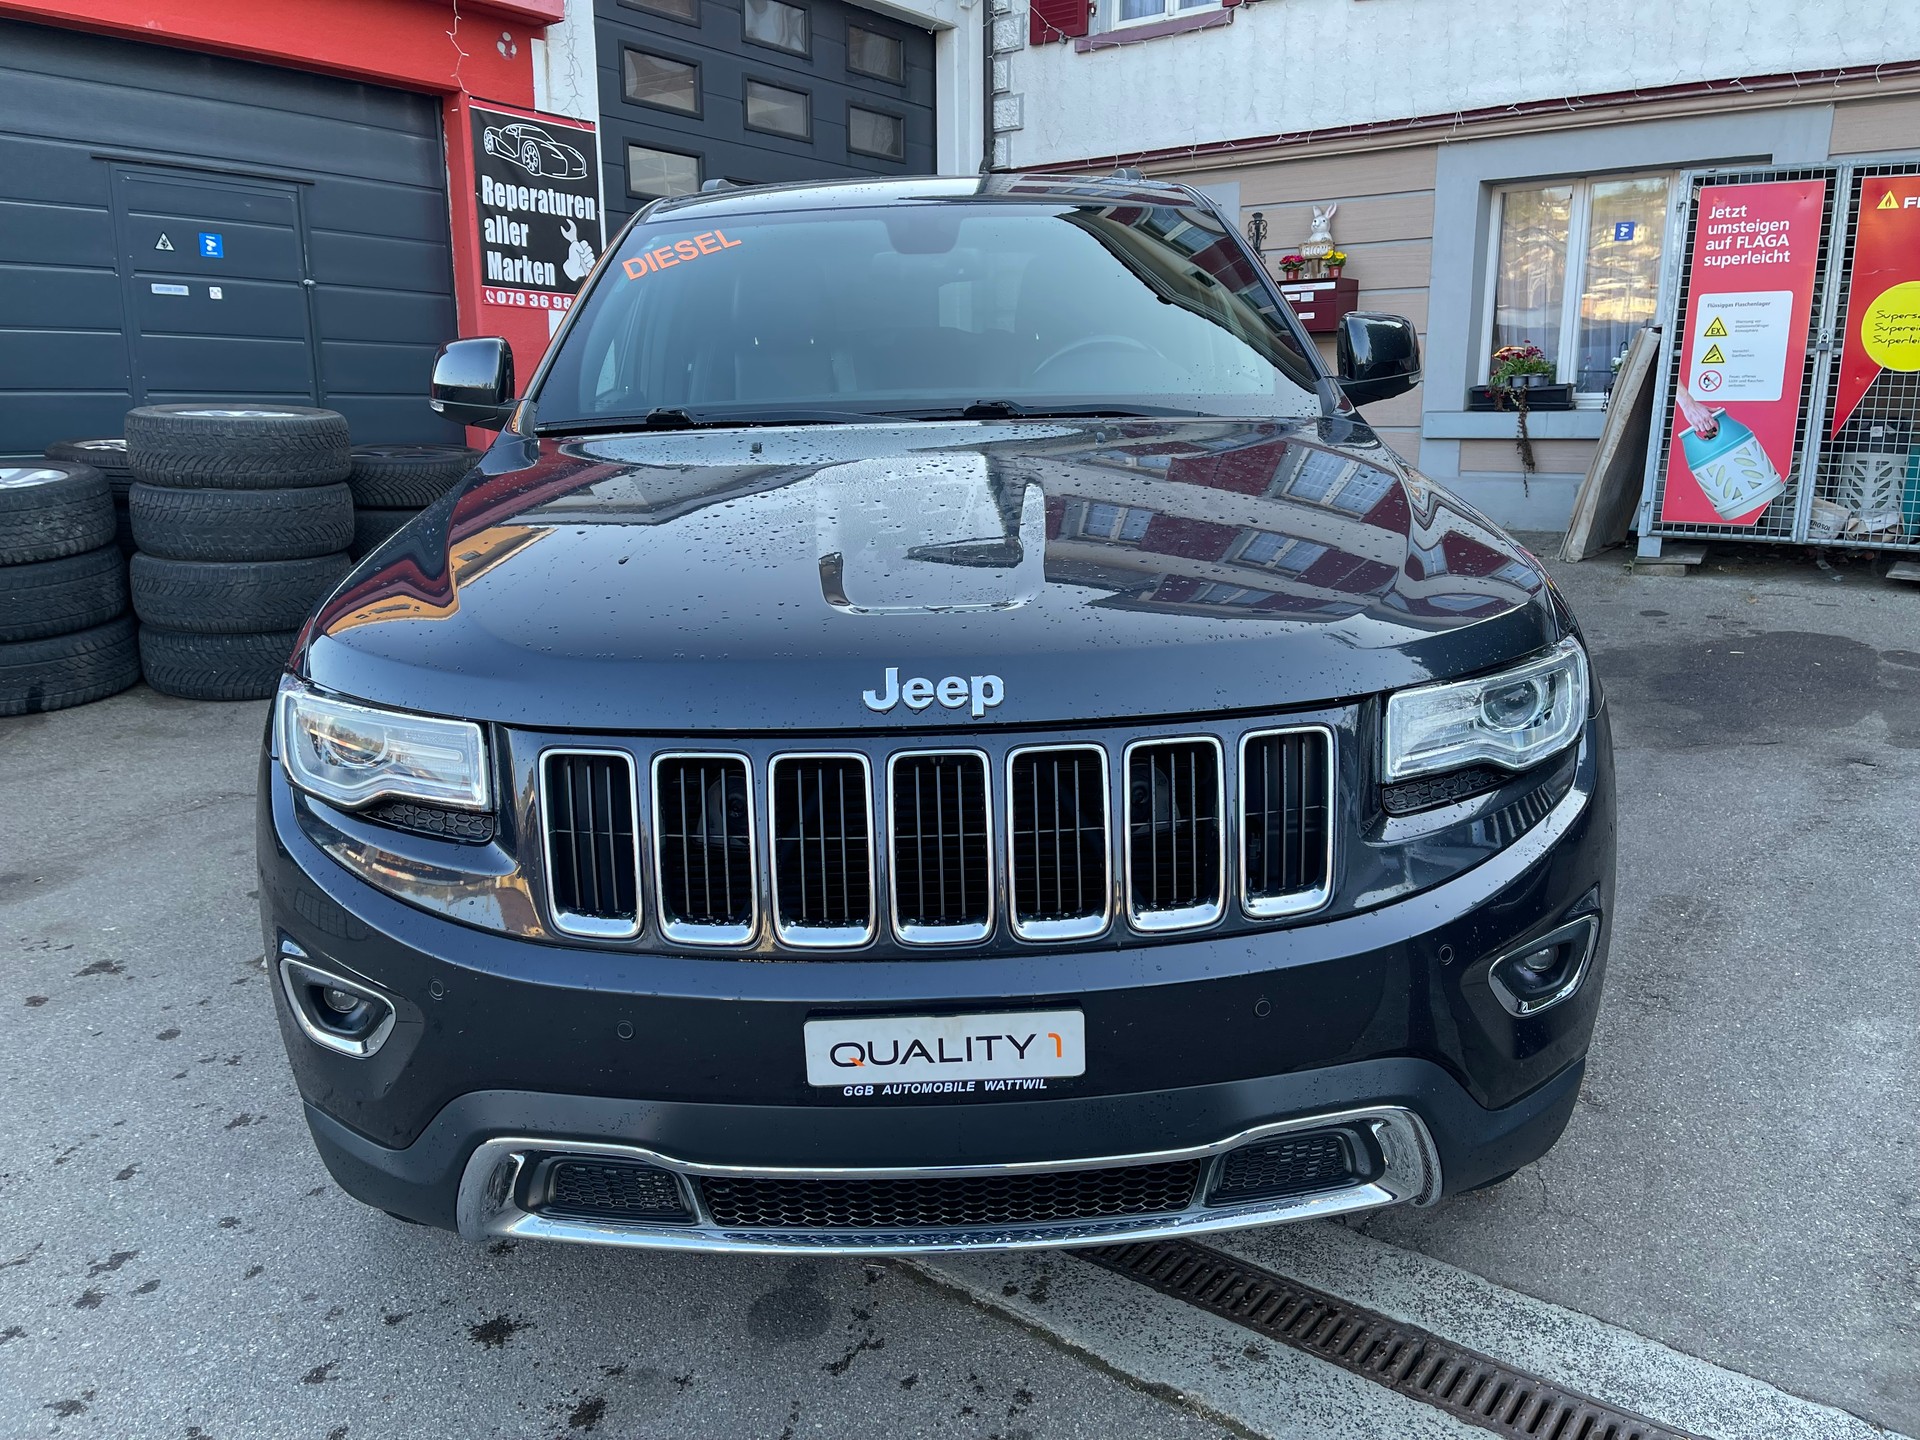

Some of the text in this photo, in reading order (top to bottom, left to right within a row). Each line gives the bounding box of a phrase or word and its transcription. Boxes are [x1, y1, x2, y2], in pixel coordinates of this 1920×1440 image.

[481, 174, 596, 220] Reperaturen
[1708, 204, 1748, 220] Jetzt
[484, 214, 529, 247] aller
[1707, 218, 1790, 236] umsteigen
[1705, 233, 1790, 251] auf FLAGA
[622, 229, 742, 280] DIESEL
[1703, 249, 1791, 269] superleicht
[486, 250, 556, 286] Marken
[496, 290, 573, 309] 079 36 98
[1711, 327, 1721, 335] EX
[862, 666, 1005, 717] Jeep
[829, 1032, 1063, 1068] QUALITY 1
[843, 1079, 1048, 1097] GGB AUTOMOBILE WATTWIL
